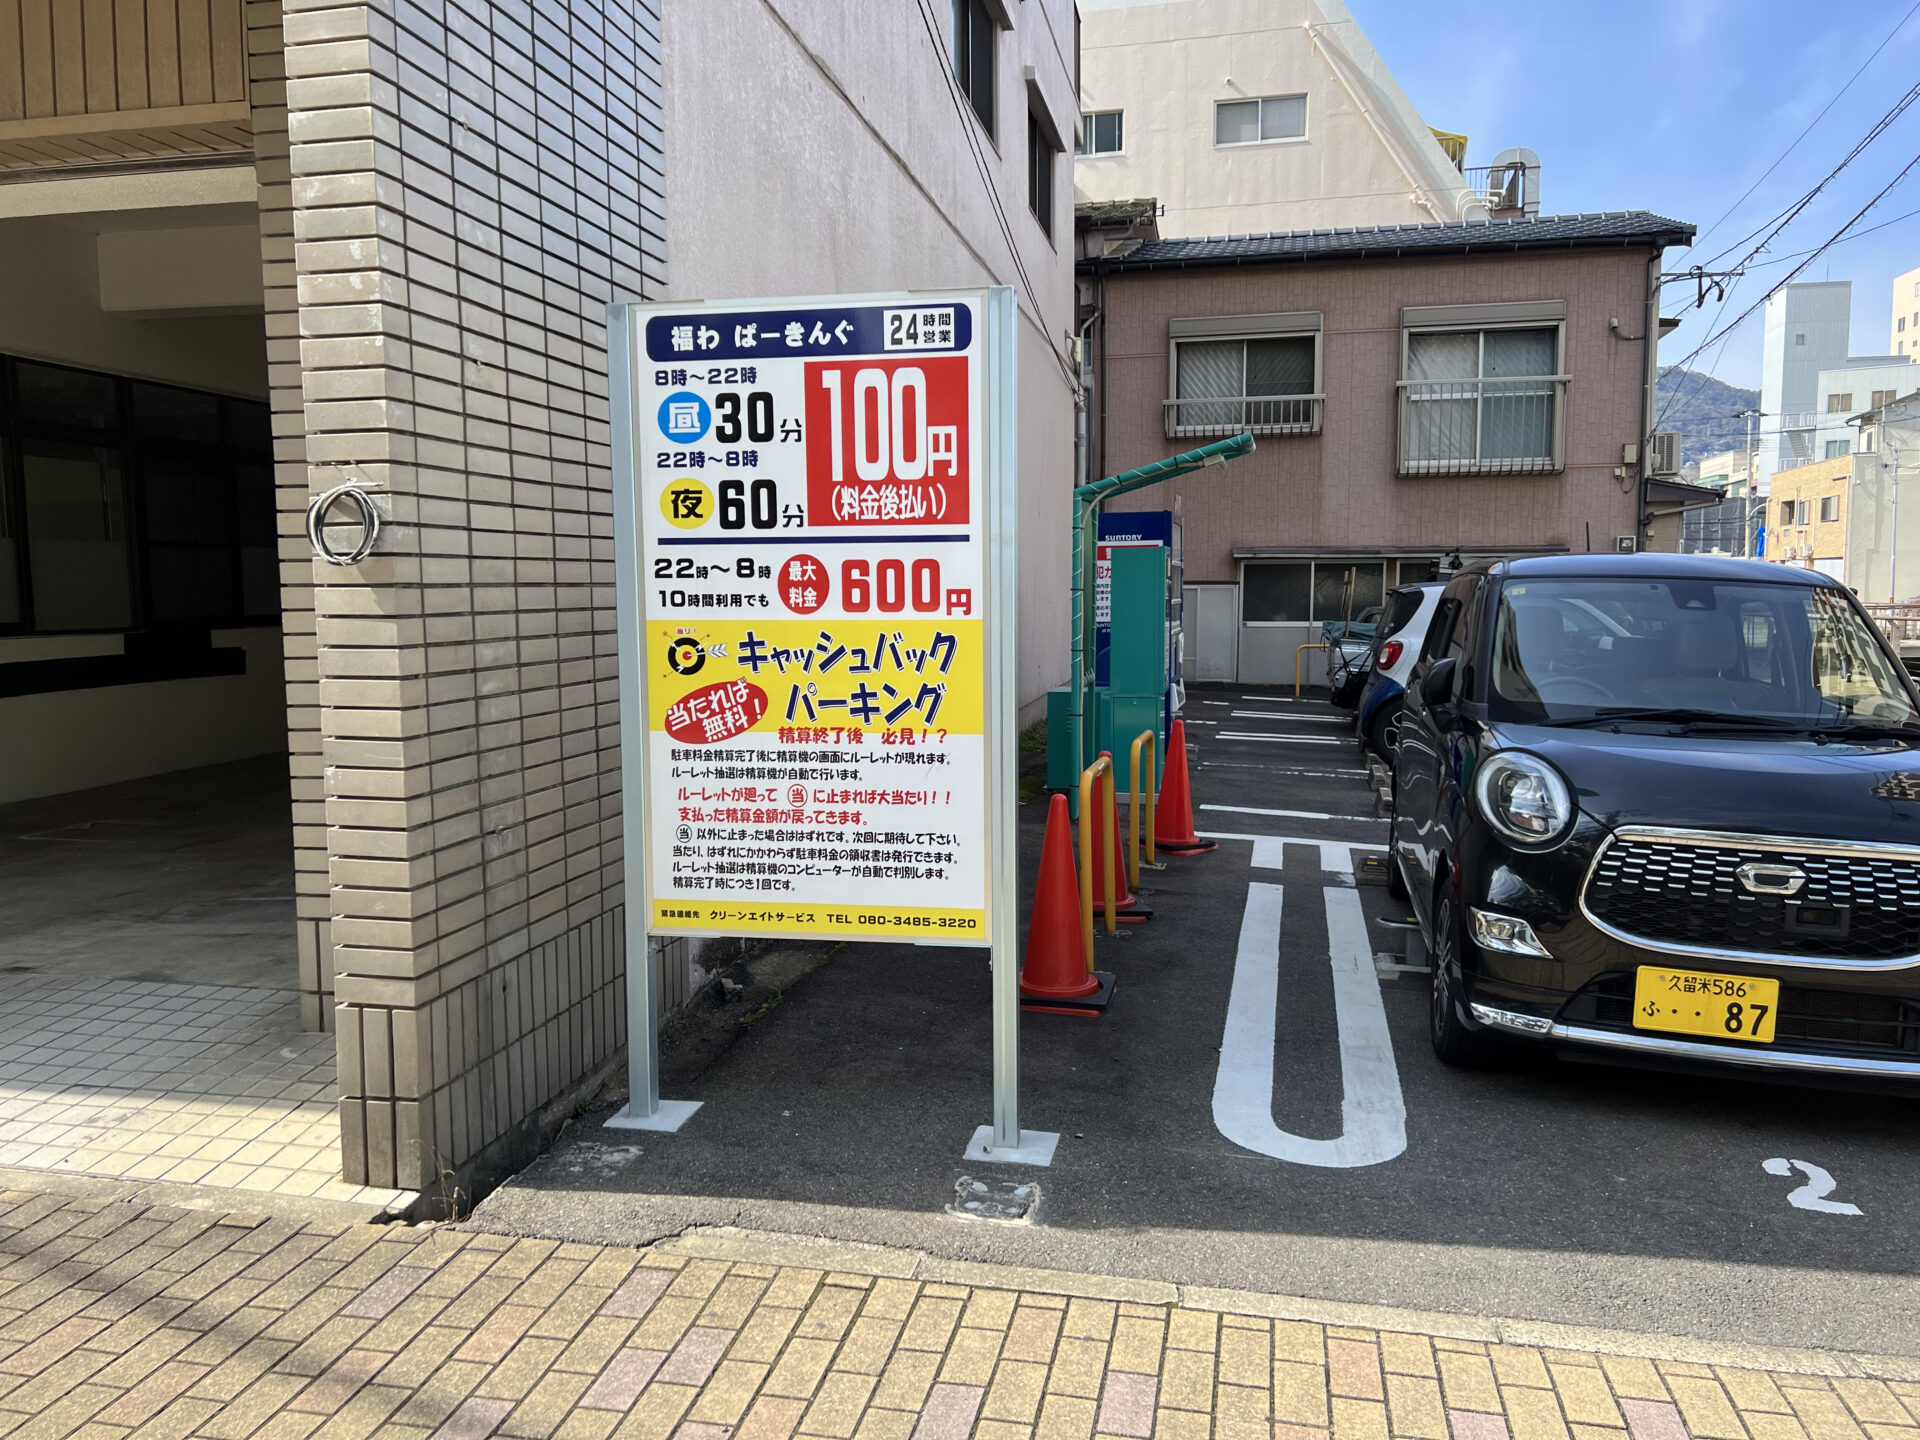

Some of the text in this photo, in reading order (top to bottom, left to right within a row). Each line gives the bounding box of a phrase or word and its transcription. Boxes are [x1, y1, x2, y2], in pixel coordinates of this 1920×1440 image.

[671, 319, 854, 352] 福わ ぱーきんぐ
[890, 313, 919, 346] 24
[923, 313, 952, 328] 時間
[923, 328, 952, 344] 営業
[668, 402, 700, 434] 昼
[671, 489, 703, 519] 夜
[788, 560, 817, 582] 最大
[841, 558, 972, 615] 600円
[659, 589, 769, 608] 10時間利用でも
[789, 585, 818, 607] 料金
[738, 630, 958, 676] キャッシュバック
[667, 676, 749, 731] 当たれば
[785, 682, 947, 727] パーキング
[778, 727, 864, 745] 精算終了後
[710, 910, 816, 923] クリーンエイトサービス
[827, 913, 853, 924] TEL
[858, 915, 977, 929] 080-3485-3220
[1762, 1158, 1864, 1215] 2
